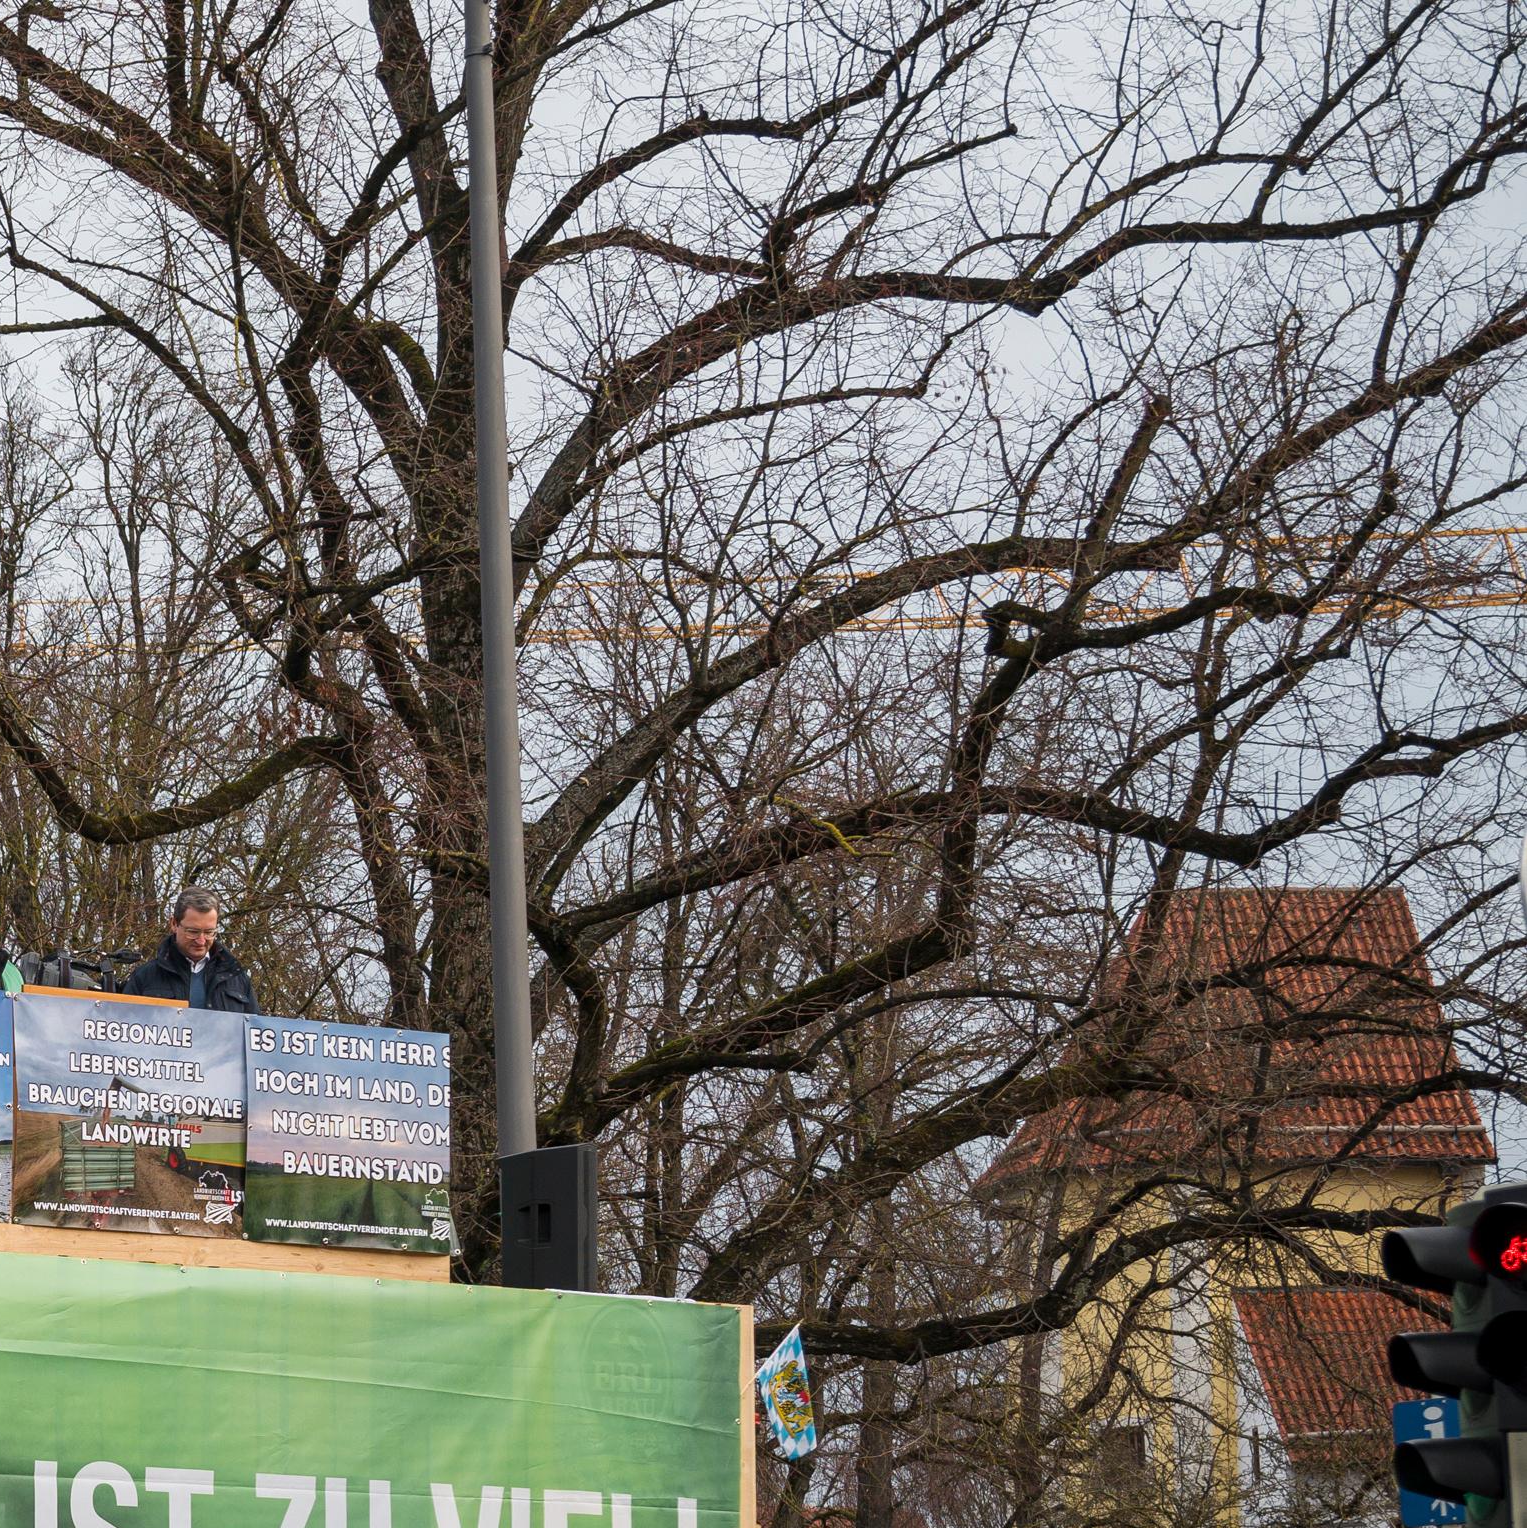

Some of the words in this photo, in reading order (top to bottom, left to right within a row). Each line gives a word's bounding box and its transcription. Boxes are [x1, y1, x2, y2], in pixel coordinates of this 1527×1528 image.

[83, 1020, 192, 1049] REGIONALE
[250, 1029, 274, 1051] ES
[279, 1032, 317, 1055] IST
[322, 1036, 373, 1061] KEIN
[381, 1040, 437, 1067] HERR
[69, 1052, 204, 1084] LEBENSMITTEL
[28, 1083, 131, 1112] BRAUCHEN
[137, 1091, 243, 1119] REGIONALE
[255, 1070, 321, 1094] HOCH
[325, 1074, 351, 1097] IM
[358, 1077, 422, 1108] LAND,
[81, 1121, 191, 1149] LANDWIRTE
[272, 1110, 343, 1138] NICHT
[348, 1116, 398, 1142] LEBT
[402, 1120, 450, 1146] VOM
[283, 1152, 443, 1185] BAUERNSTAND
[34, 1202, 200, 1220] WWW.LANDWIRTSCHAFTVERBINDET.BAYERN
[265, 1218, 428, 1237] WWW.LANDWIRTSCHAFTVERBINDET.BAYERN
